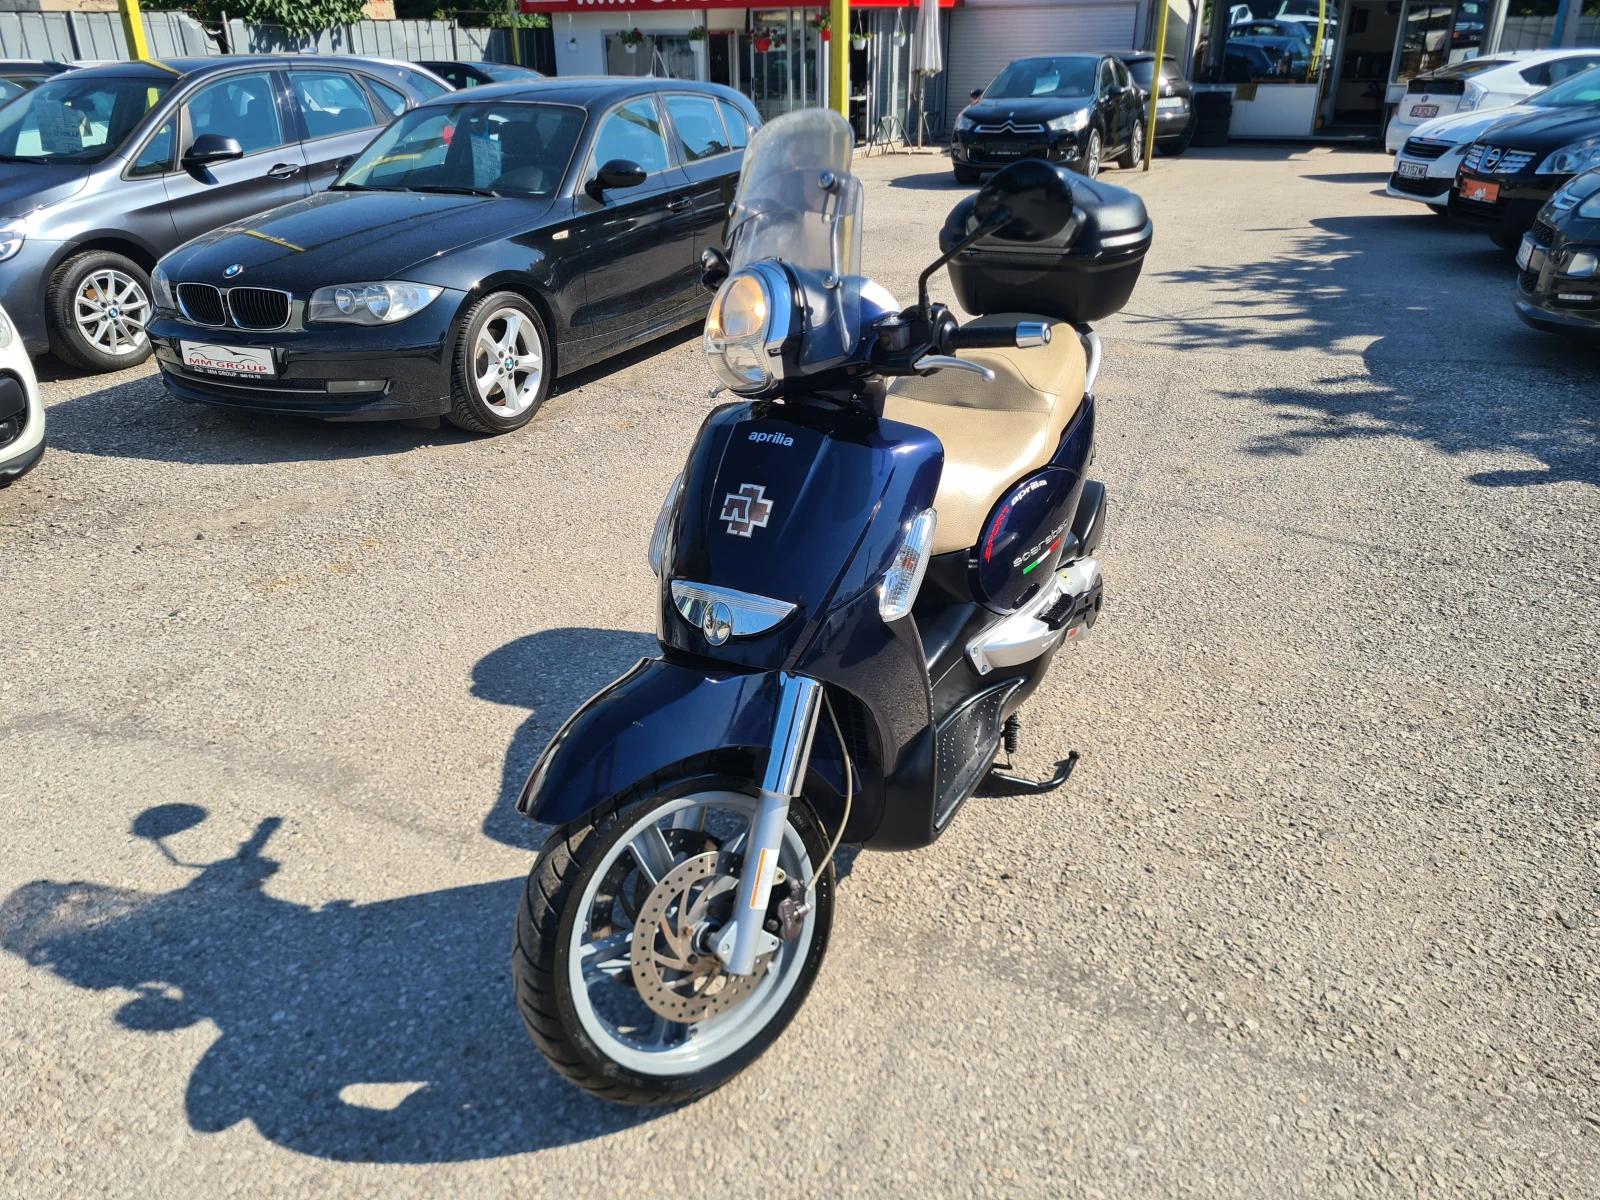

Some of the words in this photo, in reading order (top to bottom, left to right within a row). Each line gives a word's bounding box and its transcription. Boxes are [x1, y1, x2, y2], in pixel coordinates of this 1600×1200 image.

[189, 358, 212, 366] MM
[217, 362, 267, 371] GROUP
[749, 431, 794, 446] aprilia
[985, 506, 1010, 562] SPORT
[1011, 479, 1047, 506] aprilia
[1013, 519, 1068, 567] scarabeo
